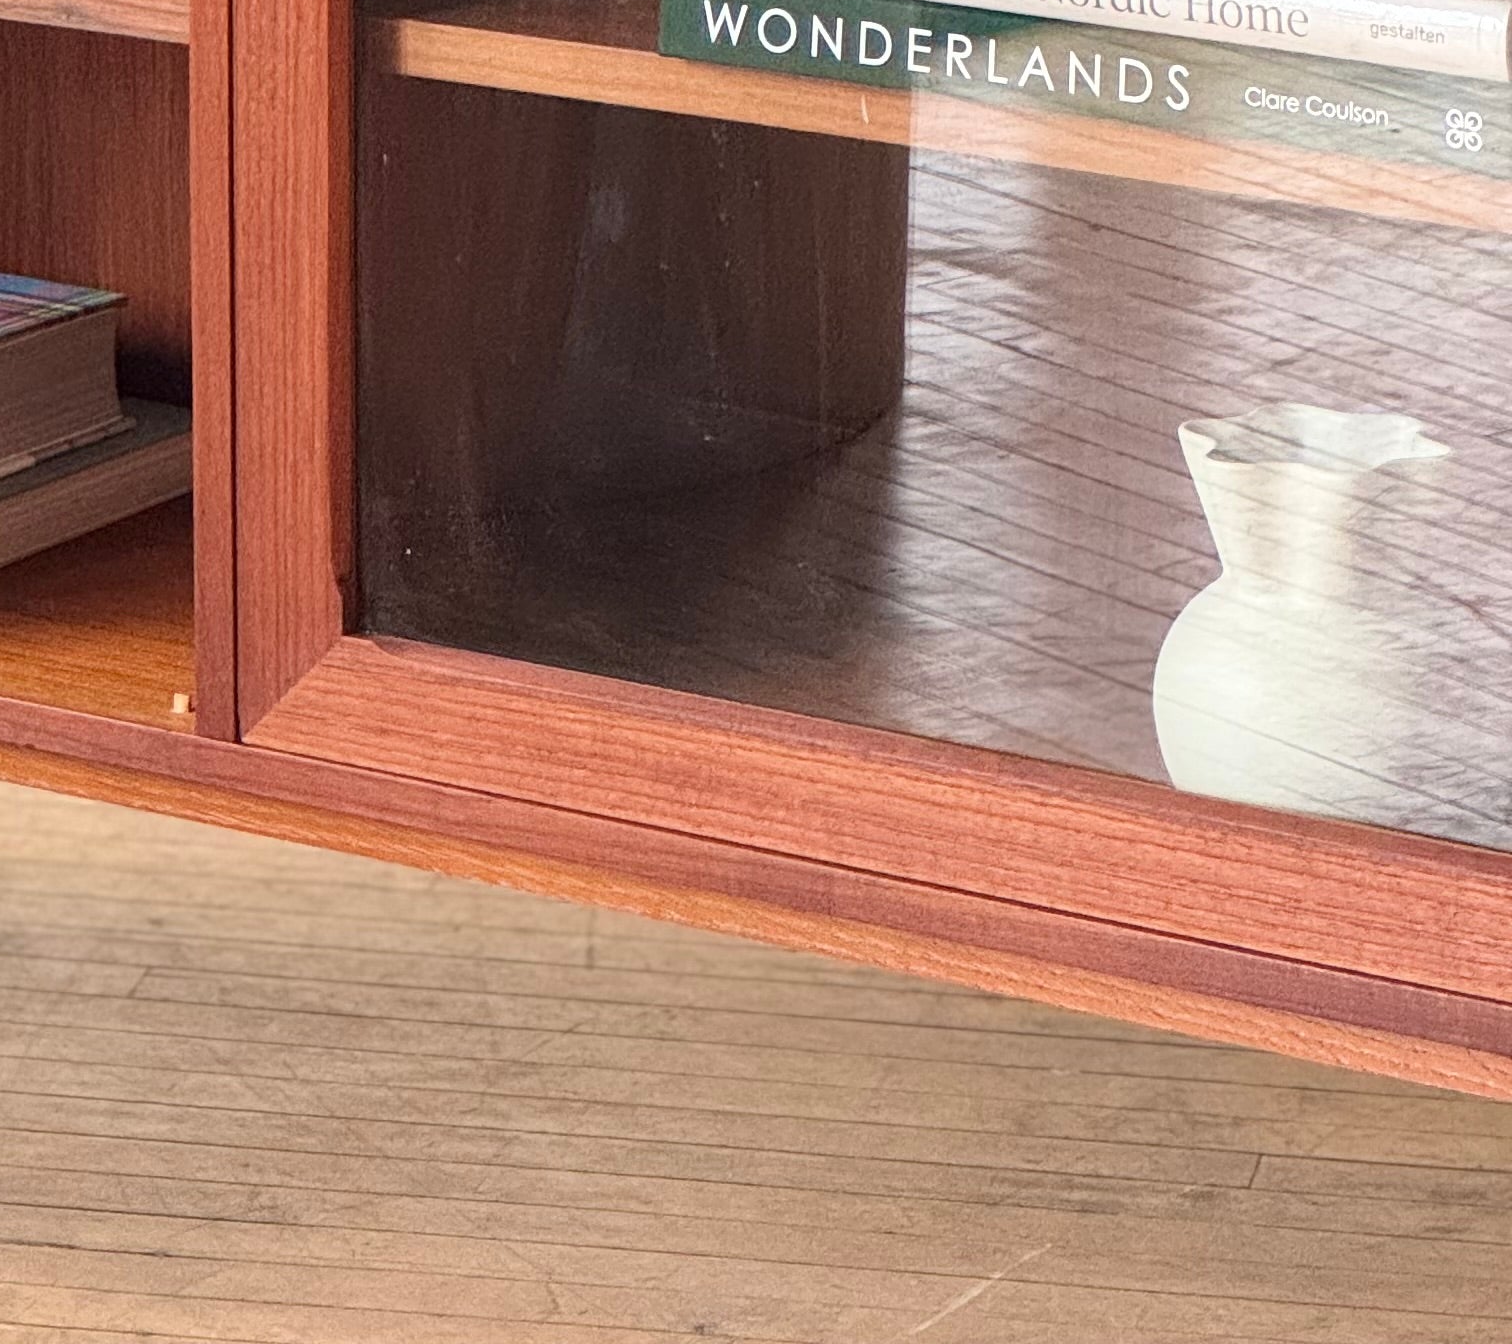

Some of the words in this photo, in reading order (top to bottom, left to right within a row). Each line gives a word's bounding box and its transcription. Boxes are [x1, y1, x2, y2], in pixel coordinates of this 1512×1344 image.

[1369, 21, 1445, 45] gestalten
[703, 0, 1191, 112] WONDERLANDS
[1244, 86, 1300, 113] Clare
[1305, 95, 1389, 127] Coulson
